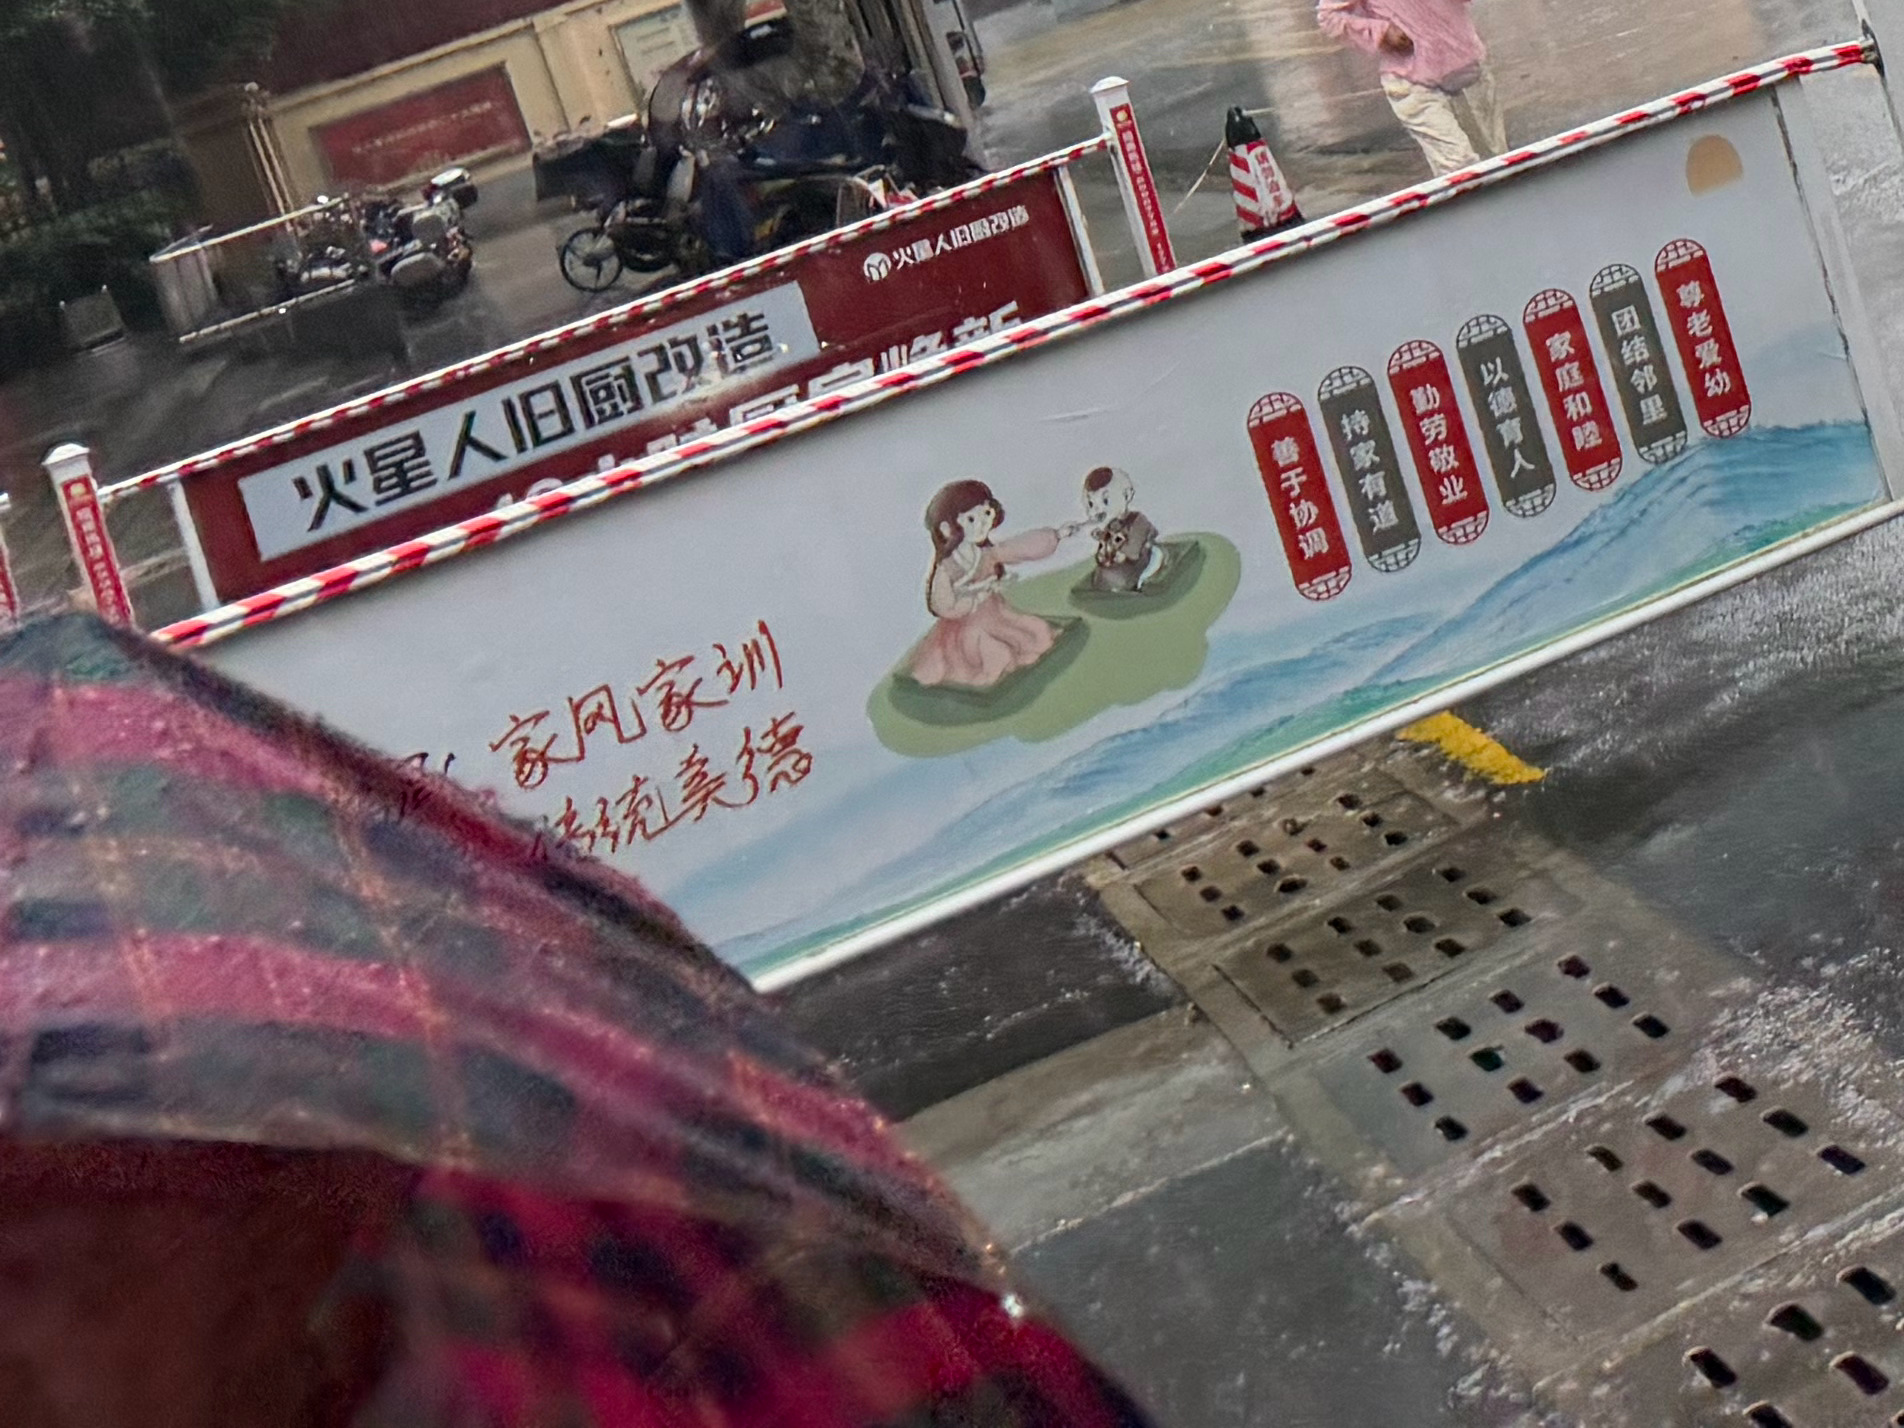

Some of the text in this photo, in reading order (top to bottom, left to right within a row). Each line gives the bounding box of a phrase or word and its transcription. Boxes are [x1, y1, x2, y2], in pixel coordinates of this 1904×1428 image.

[1545, 330, 1602, 451] 家庭和睦
[1611, 305, 1669, 425] 团结邻里
[1677, 278, 1734, 399] 尊老爱幼
[292, 309, 784, 532] 火星人旧厨改造
[1341, 408, 1401, 533] 持家有道
[1409, 385, 1470, 506] 勤劳敬业
[1479, 358, 1536, 479] 以德育人
[1271, 437, 1331, 559] 善于协调
[489, 619, 782, 790] 家风家训
